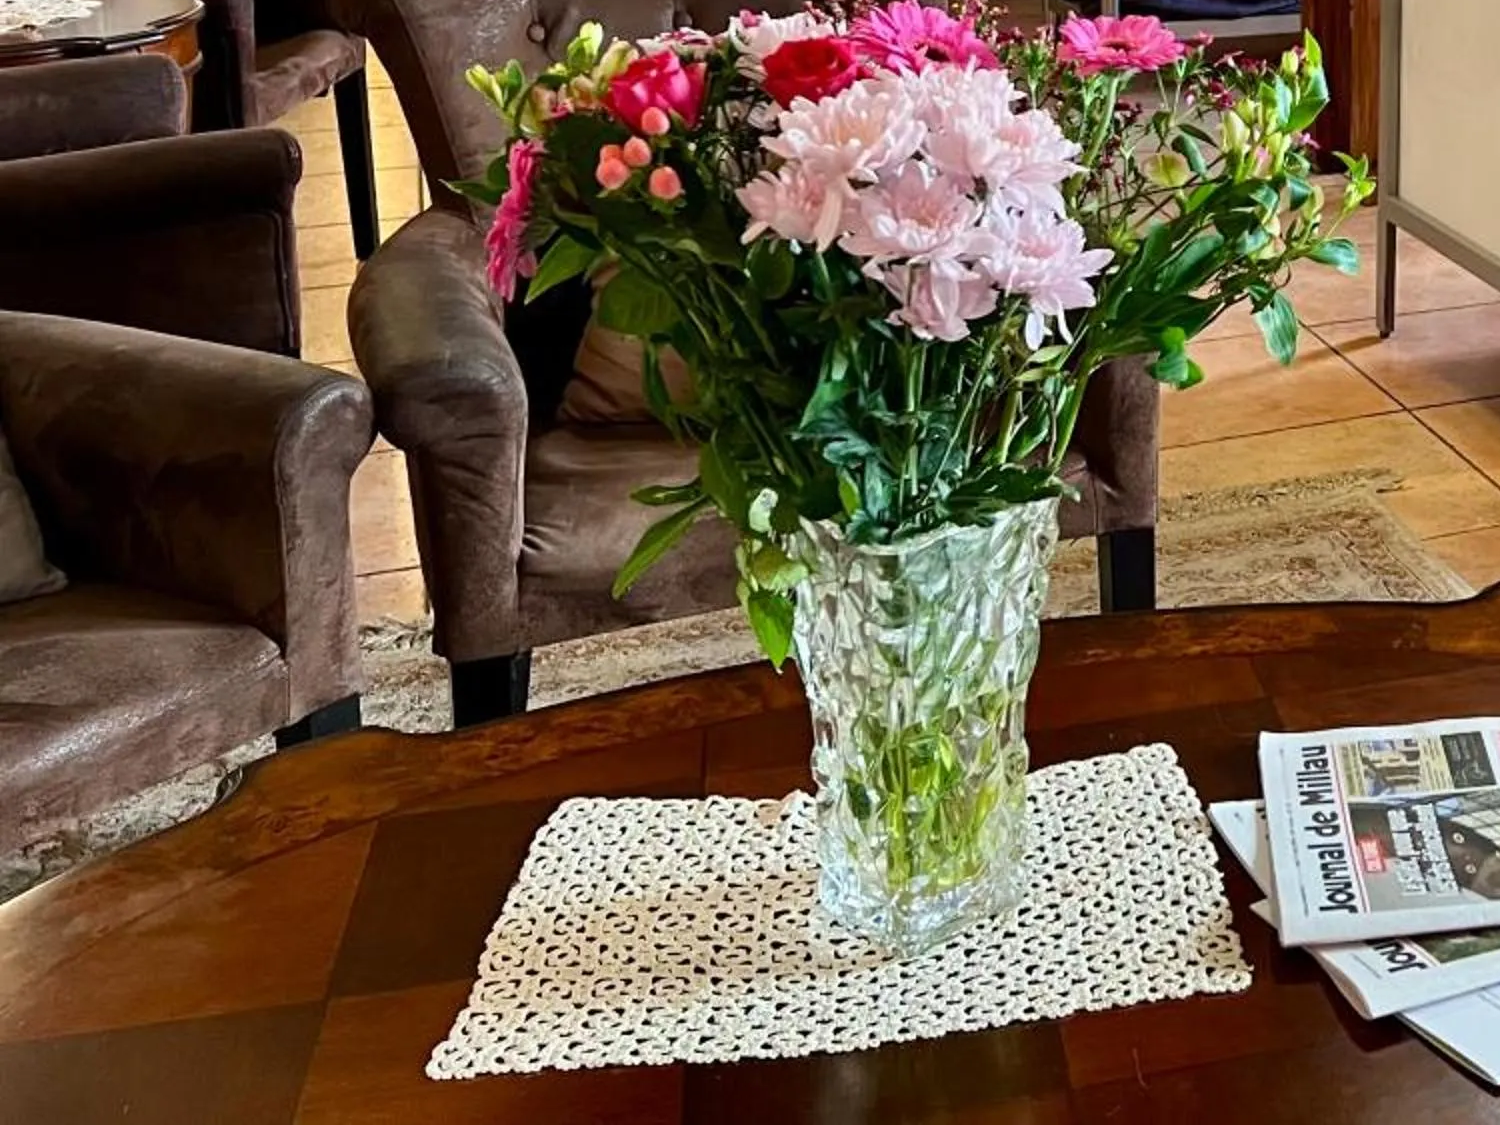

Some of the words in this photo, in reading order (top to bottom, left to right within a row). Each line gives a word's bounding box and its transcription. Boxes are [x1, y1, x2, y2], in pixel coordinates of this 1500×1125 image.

[1295, 744, 1336, 806] Millau
[1303, 809, 1341, 838] de
[1306, 842, 1359, 914] Journal
